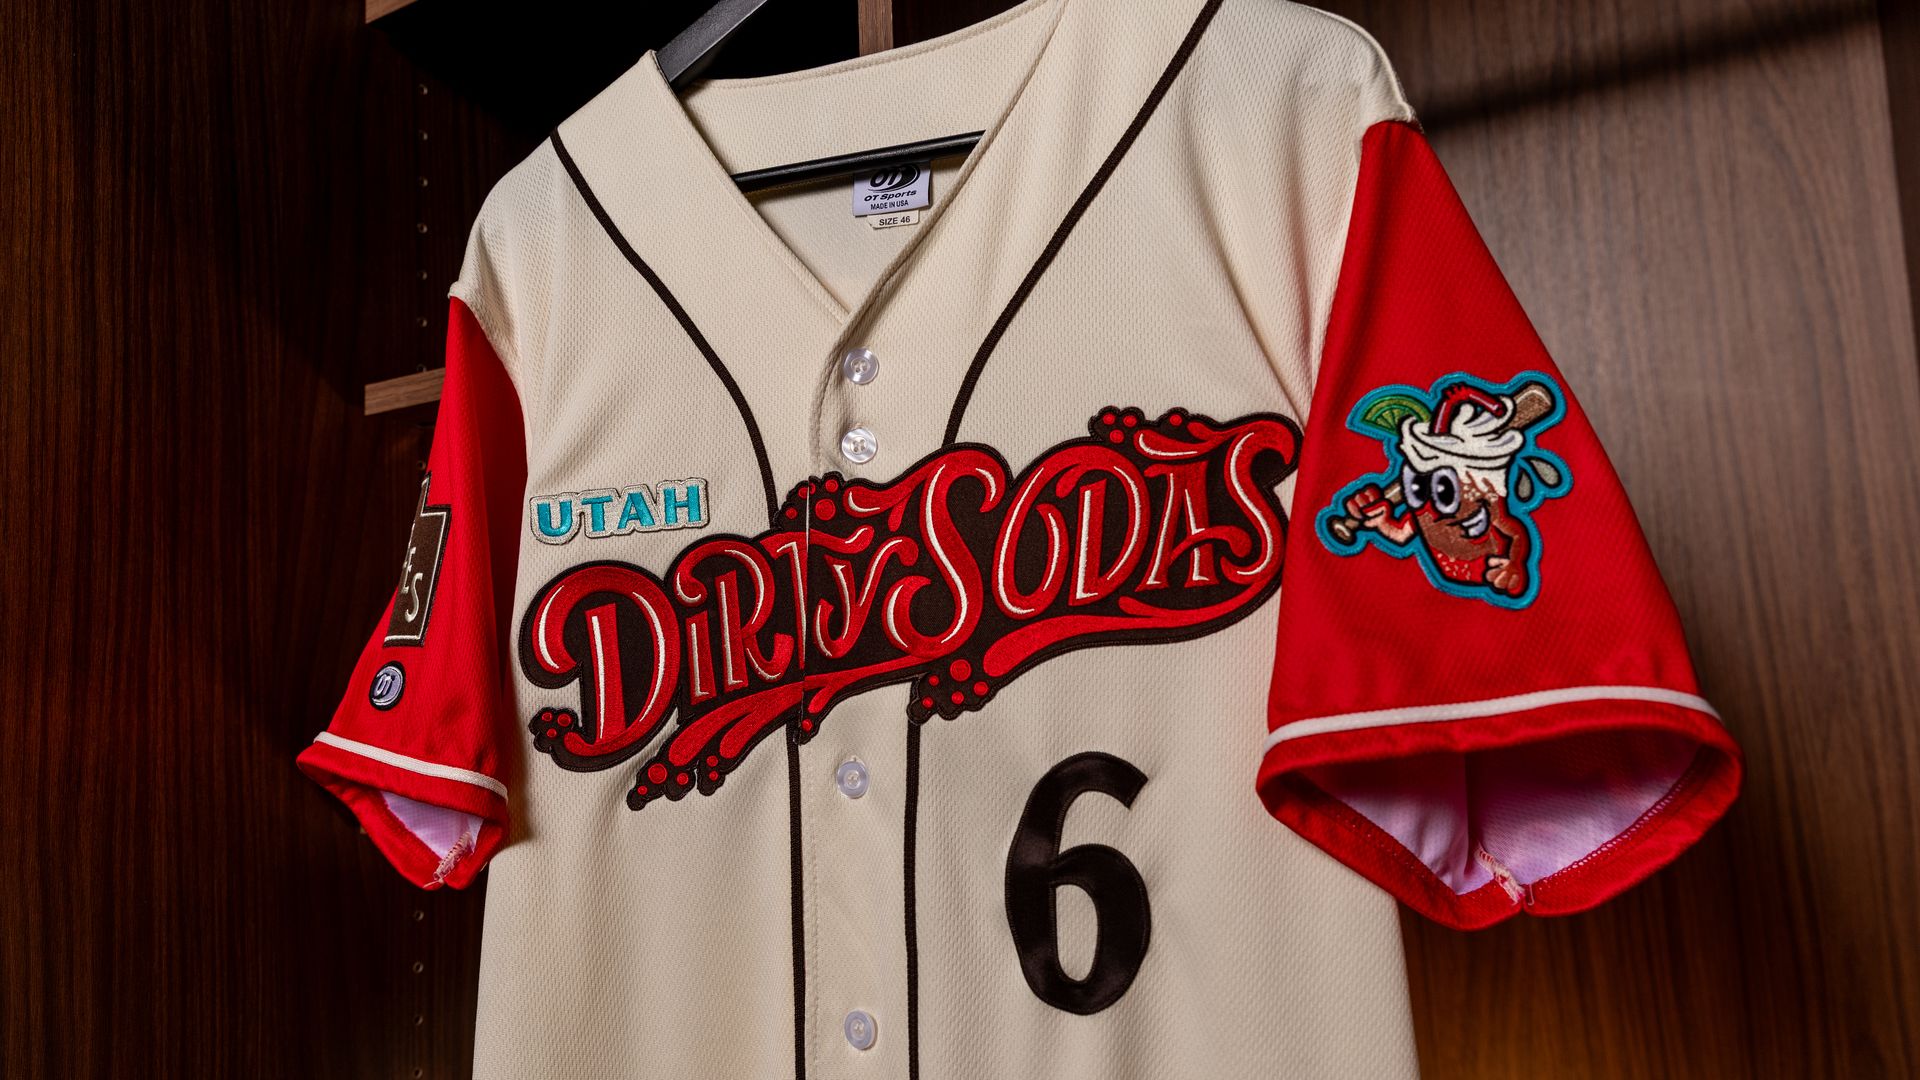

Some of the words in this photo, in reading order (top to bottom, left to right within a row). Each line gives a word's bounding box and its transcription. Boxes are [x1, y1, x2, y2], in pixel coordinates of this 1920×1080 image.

[864, 194, 879, 202] OT
[880, 190, 917, 200] Sports
[879, 217, 898, 226] SIZE
[536, 484, 703, 538] UTAH
[882, 420, 1296, 659] SODAS
[1004, 751, 1151, 1016] 6
